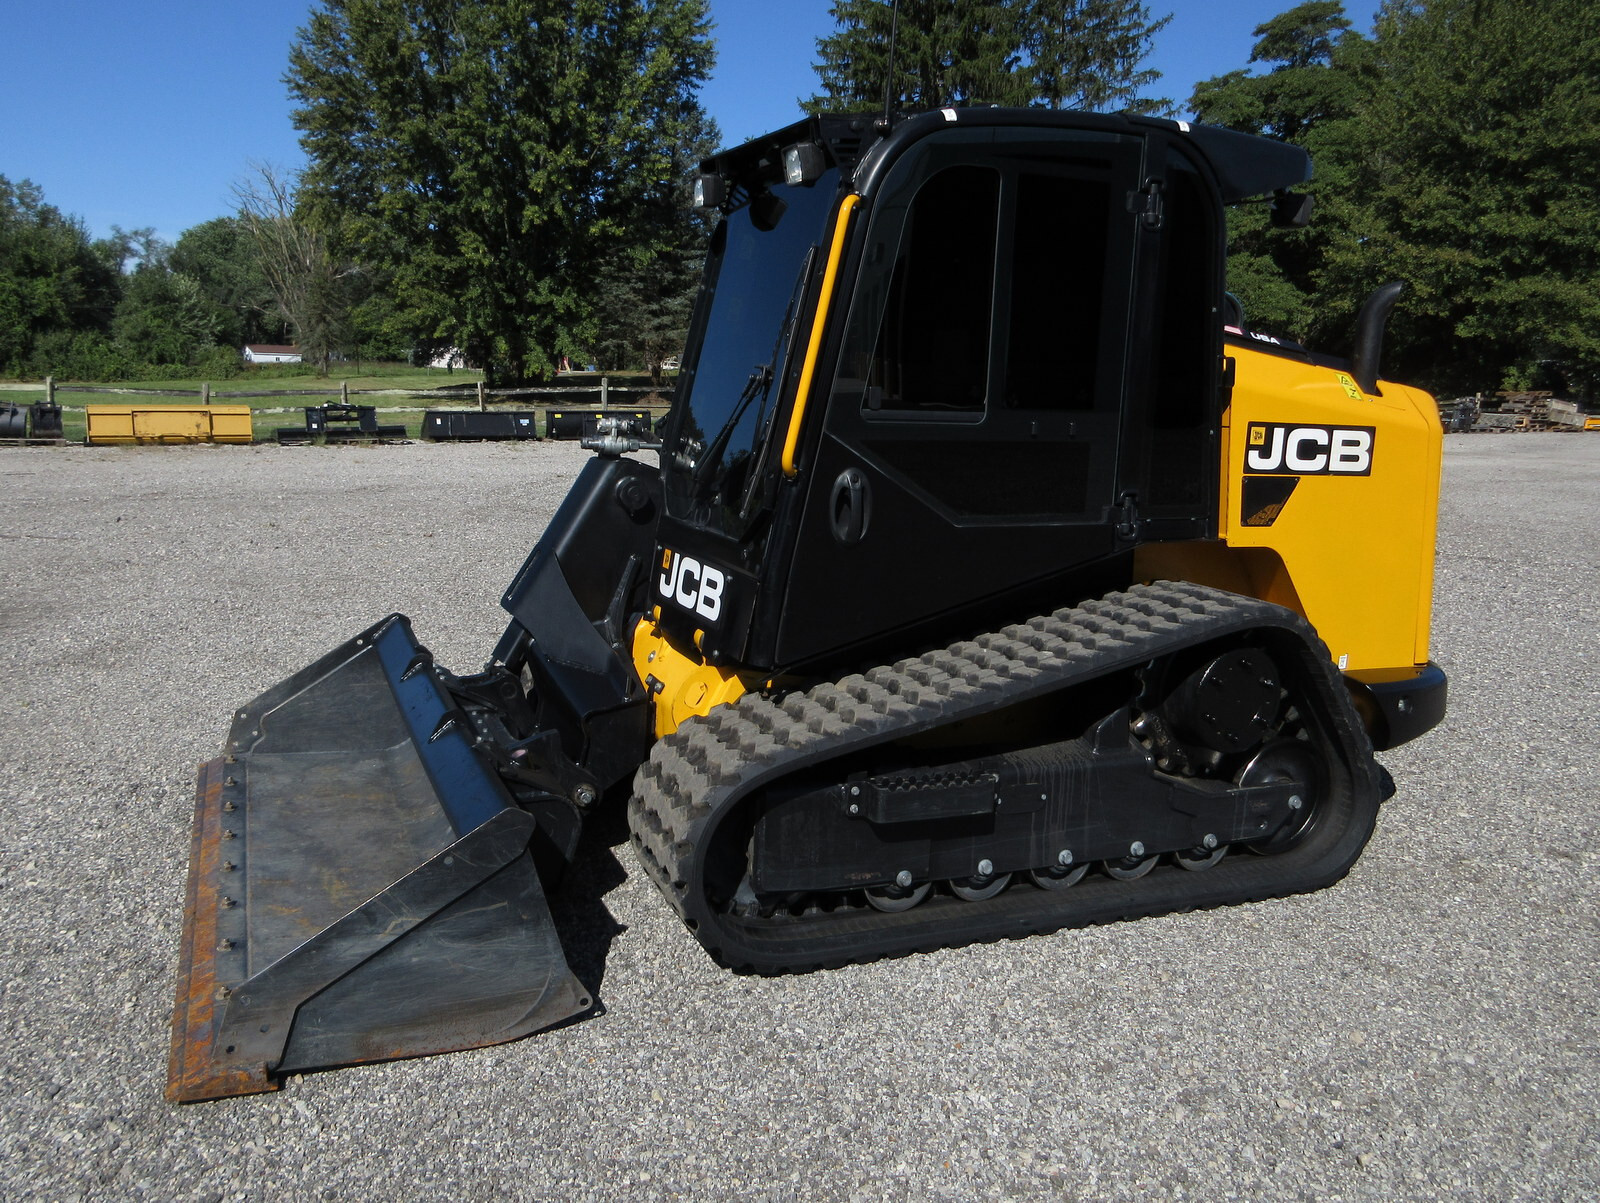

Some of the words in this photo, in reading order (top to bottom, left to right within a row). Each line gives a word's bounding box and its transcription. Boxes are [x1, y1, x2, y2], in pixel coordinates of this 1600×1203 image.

[1250, 331, 1281, 345] USA
[1248, 427, 1371, 472] JCB
[659, 552, 725, 622] JCB
